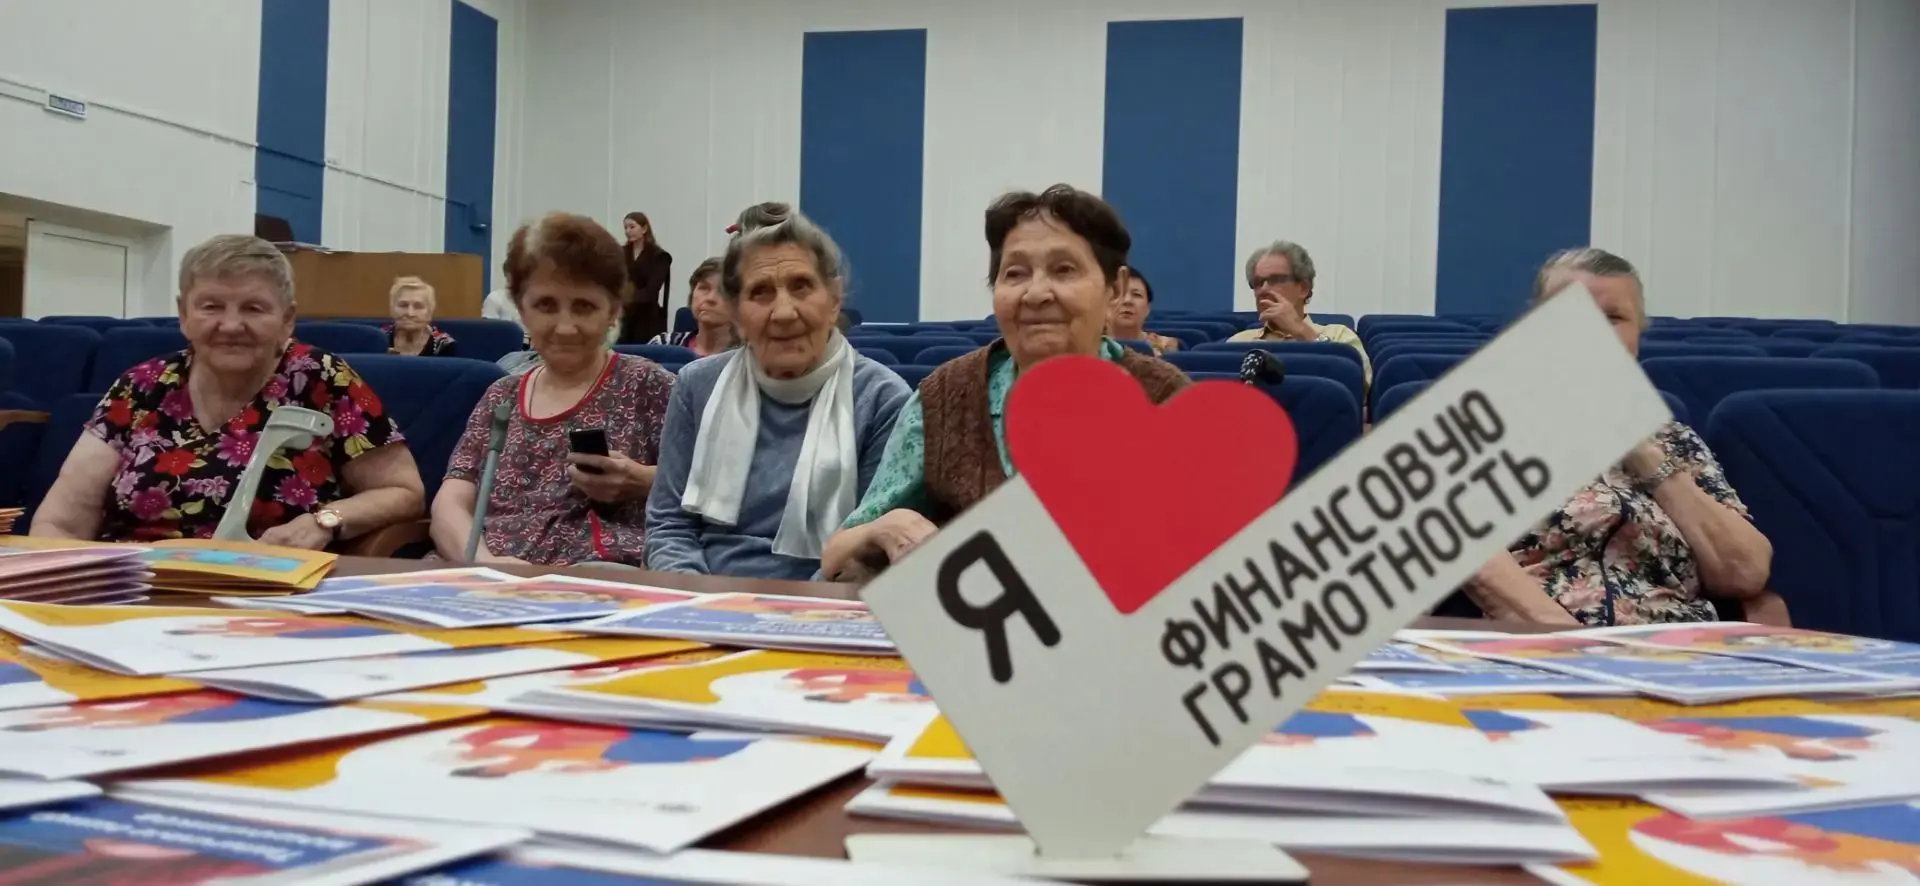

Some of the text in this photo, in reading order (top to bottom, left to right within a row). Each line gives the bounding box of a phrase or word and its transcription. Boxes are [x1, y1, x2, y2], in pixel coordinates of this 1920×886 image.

[936, 530, 1062, 684] Я
[1160, 390, 1505, 671] ФИНАНСОВУЮ
[1182, 450, 1551, 747] ГРАМОТНОСТЬ
